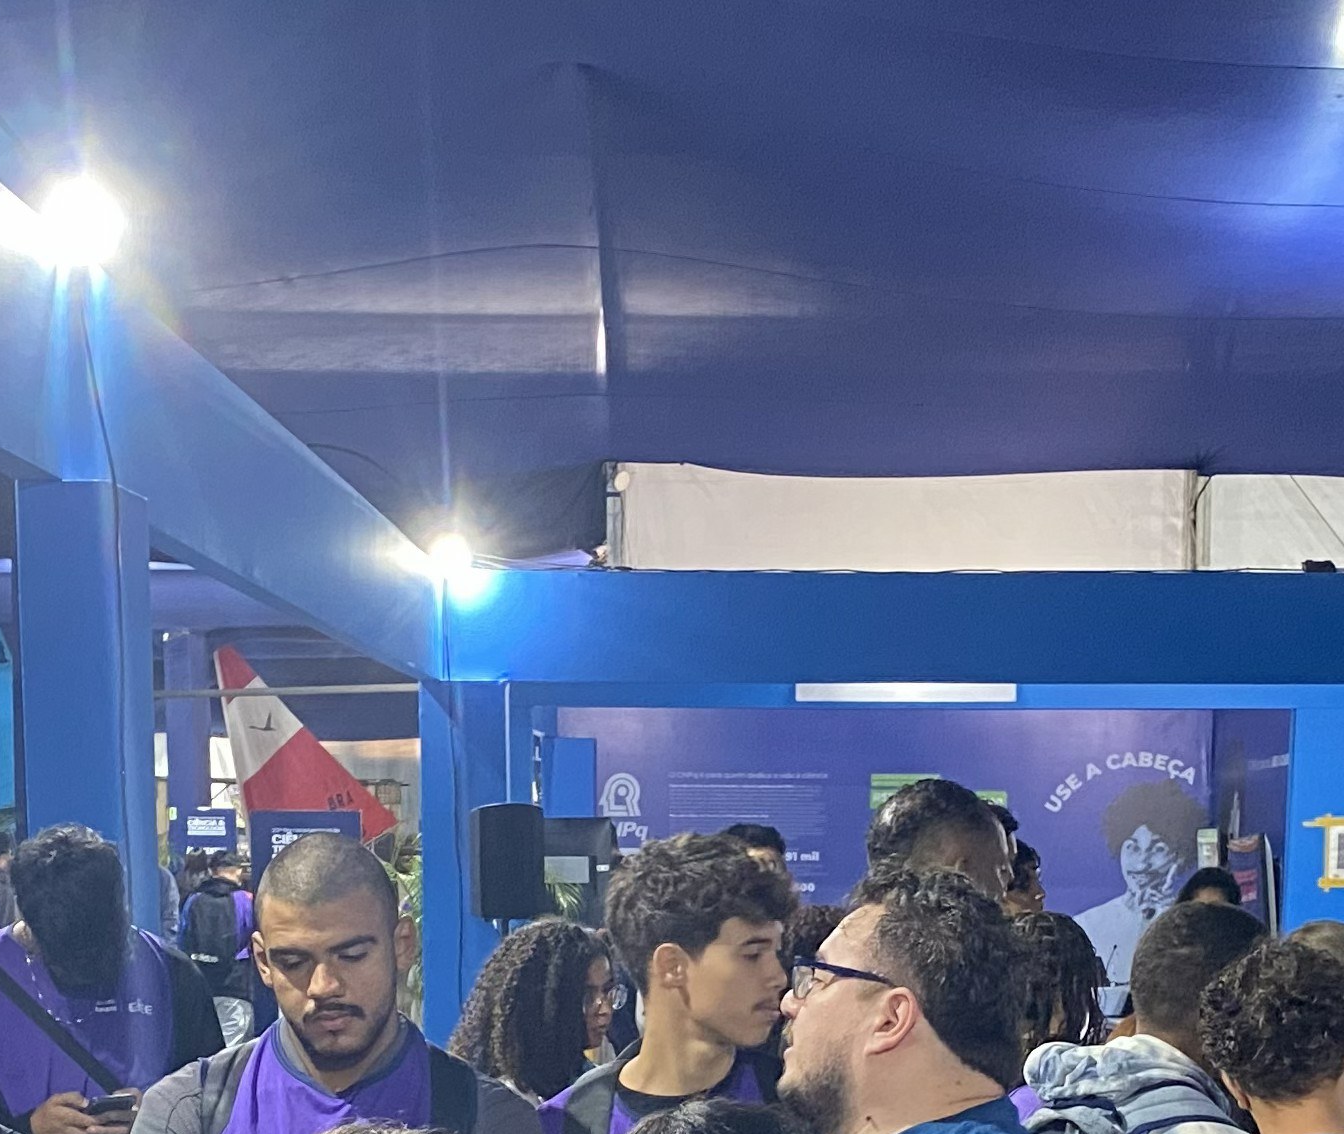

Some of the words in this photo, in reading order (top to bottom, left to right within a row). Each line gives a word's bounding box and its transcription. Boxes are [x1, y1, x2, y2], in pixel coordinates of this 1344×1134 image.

[1044, 773, 1083, 813] USE
[1086, 762, 1102, 781] A
[1106, 751, 1196, 786] CABEÇA
